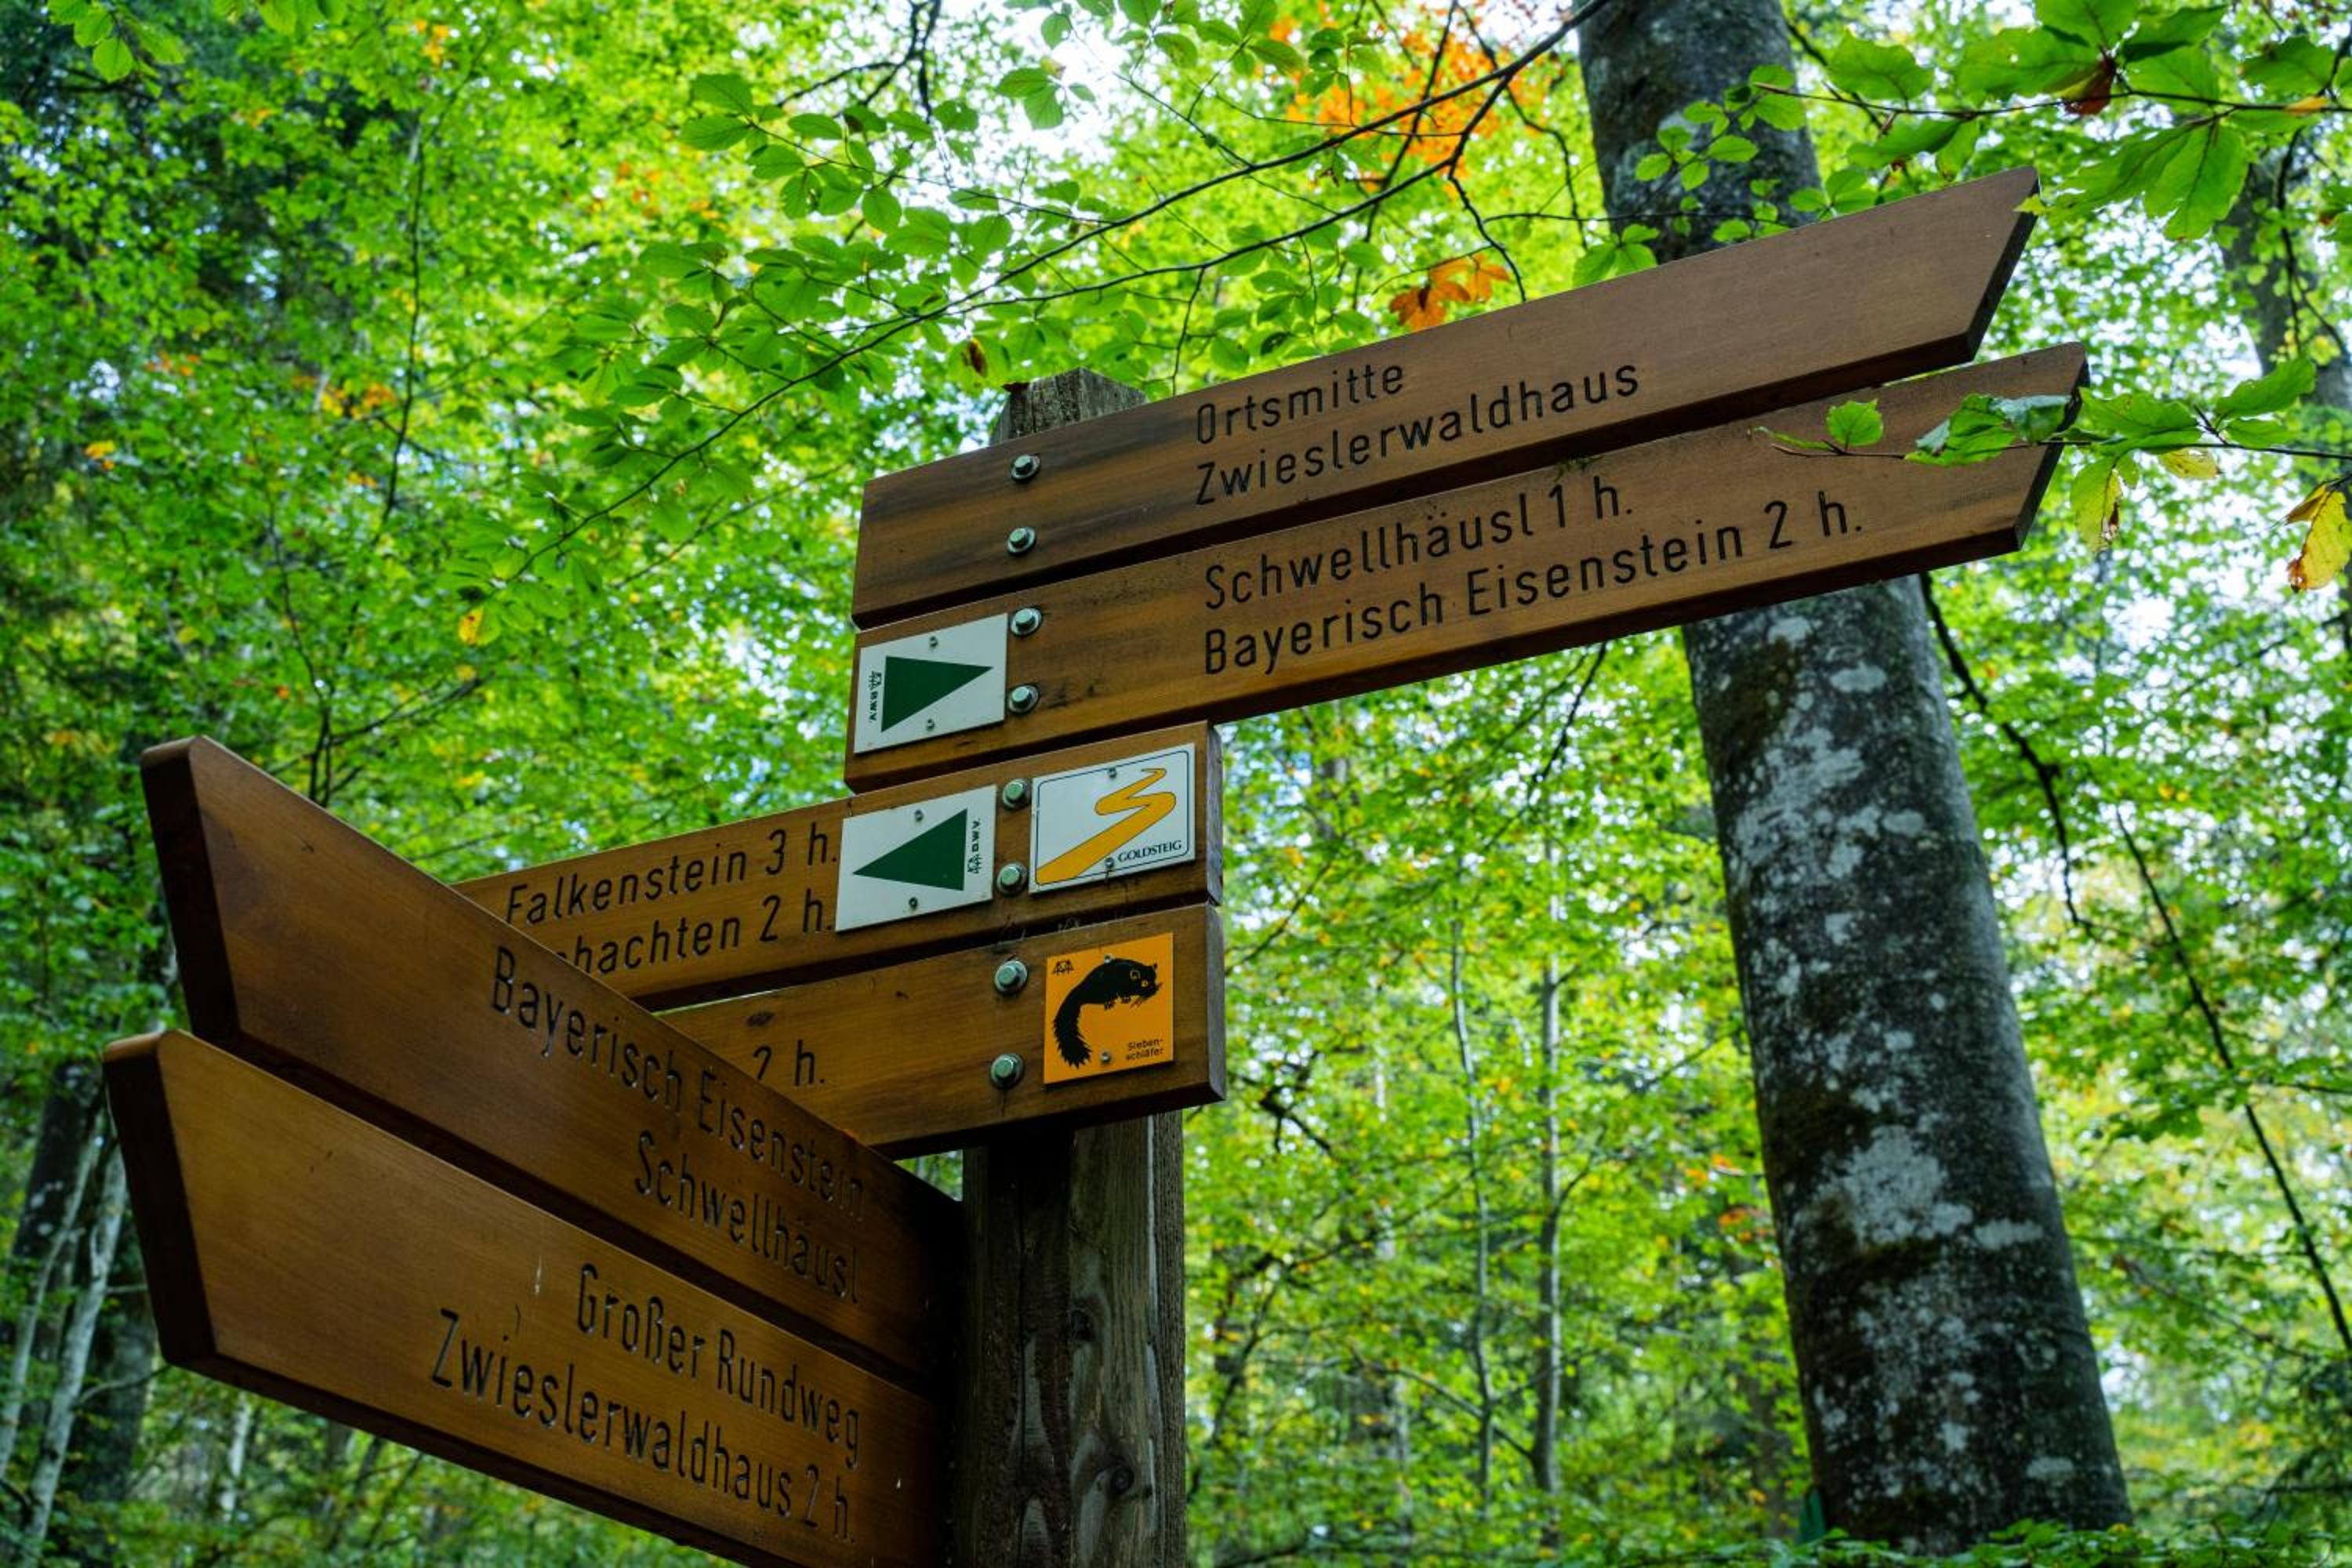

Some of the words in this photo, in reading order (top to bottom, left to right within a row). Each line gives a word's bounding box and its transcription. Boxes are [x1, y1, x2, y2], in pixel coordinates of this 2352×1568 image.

[1196, 364, 1404, 445] Ortsmitte
[1196, 364, 1639, 506] Zwieslerwaldhaus
[1205, 493, 1534, 610] Schwellhäusl
[1550, 484, 1566, 528] 1
[1594, 476, 1633, 520] h.
[1205, 583, 1443, 676] Bayerisch
[1468, 520, 1742, 617] Eisenstein
[1764, 501, 1793, 550] 2
[1820, 491, 1863, 536] h.
[506, 843, 747, 925] Falkenstein
[765, 829, 786, 875] 3
[807, 822, 837, 866] h.
[1118, 840, 1181, 862] GOLDSTEIG
[556, 916, 741, 975] hachten
[759, 895, 781, 942] 2
[802, 888, 833, 934] h.
[492, 946, 682, 1116] Bayerisch
[699, 1068, 863, 1221] Eisenstein
[794, 1040, 826, 1087] h.
[635, 1130, 858, 1305] Schwellhäusl
[431, 1308, 792, 1519] Zwieslerwaldhaus
[801, 1463, 820, 1530] 2
[576, 1262, 705, 1378] Großer
[717, 1329, 860, 1470] Rundweg
